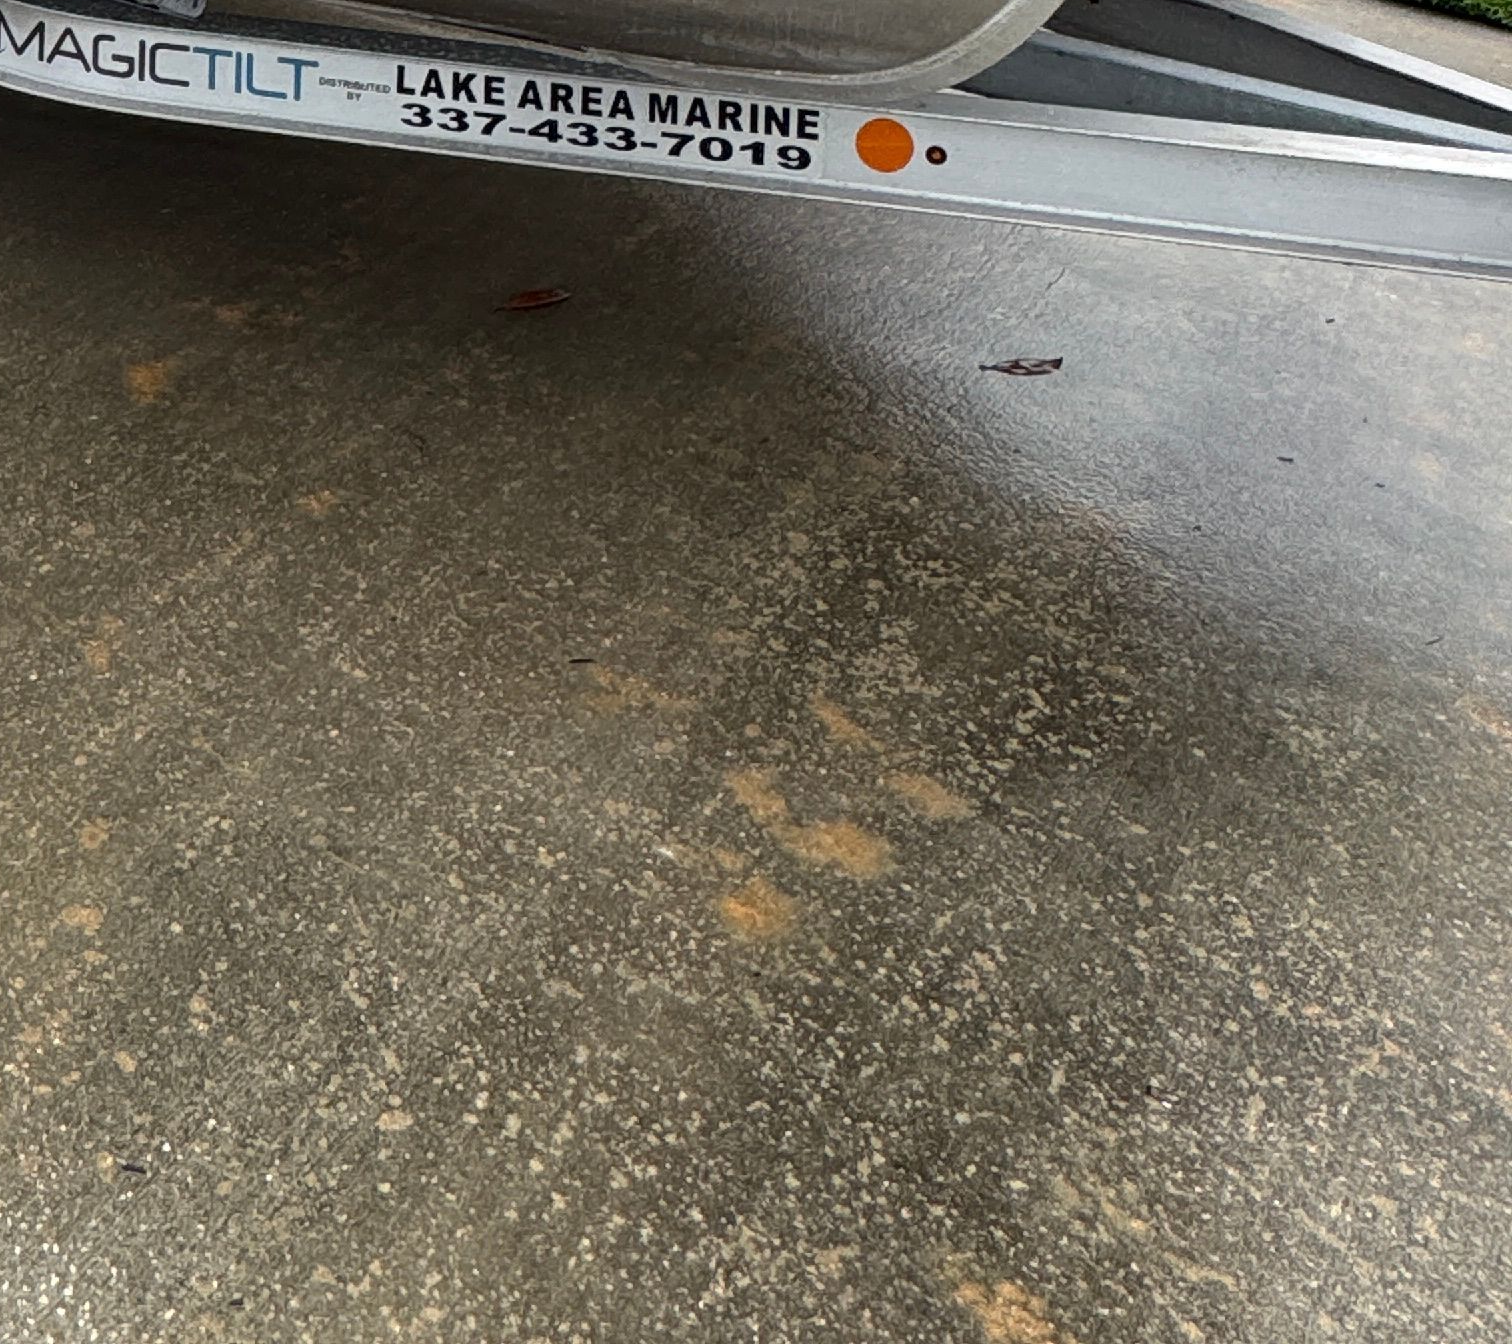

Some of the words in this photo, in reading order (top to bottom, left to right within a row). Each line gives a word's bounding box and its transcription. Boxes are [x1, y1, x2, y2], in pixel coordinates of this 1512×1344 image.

[397, 65, 505, 106] LAKE
[518, 81, 635, 121] AREA
[648, 92, 820, 141] MARINE
[401, 103, 812, 170] 337-433-7019
